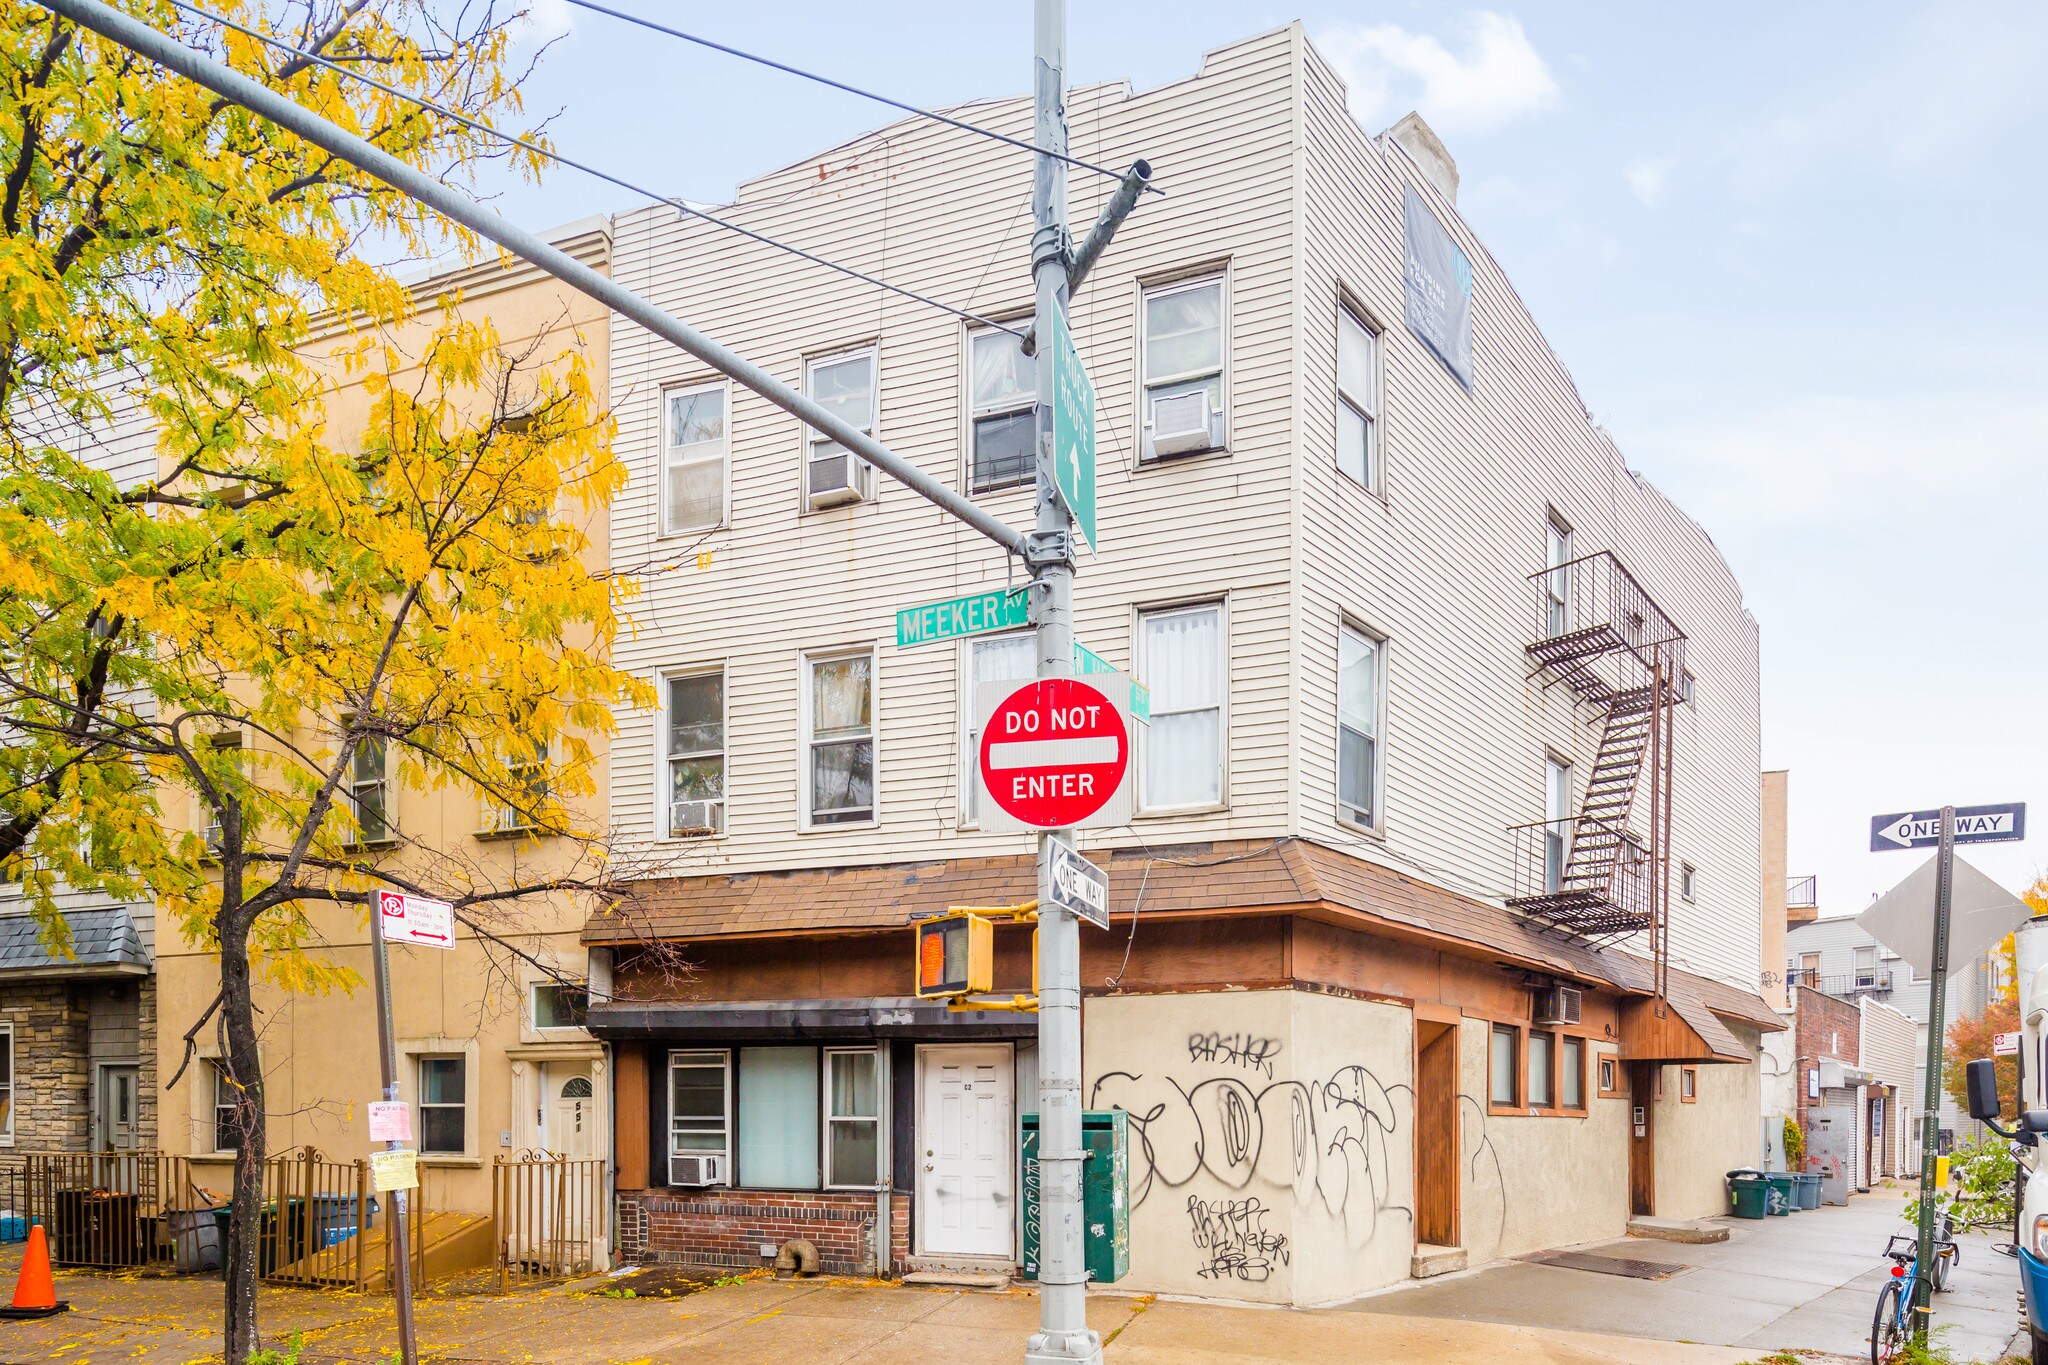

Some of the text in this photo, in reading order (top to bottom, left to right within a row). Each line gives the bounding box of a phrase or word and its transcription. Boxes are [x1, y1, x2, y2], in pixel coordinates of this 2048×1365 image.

[1410, 254, 1446, 299] BUILDING
[1410, 267, 1426, 289] FOR
[1428, 286, 1446, 311] SALE
[1060, 333, 1089, 416] TRUCK
[1060, 372, 1089, 455] ROUTE
[903, 588, 1024, 643] MEEKER AV
[1005, 705, 1101, 734] DO NOT
[1012, 773, 1094, 800] ENTER
[1898, 816, 2003, 838] ONE WAY
[1059, 864, 1103, 907] ONE WAY
